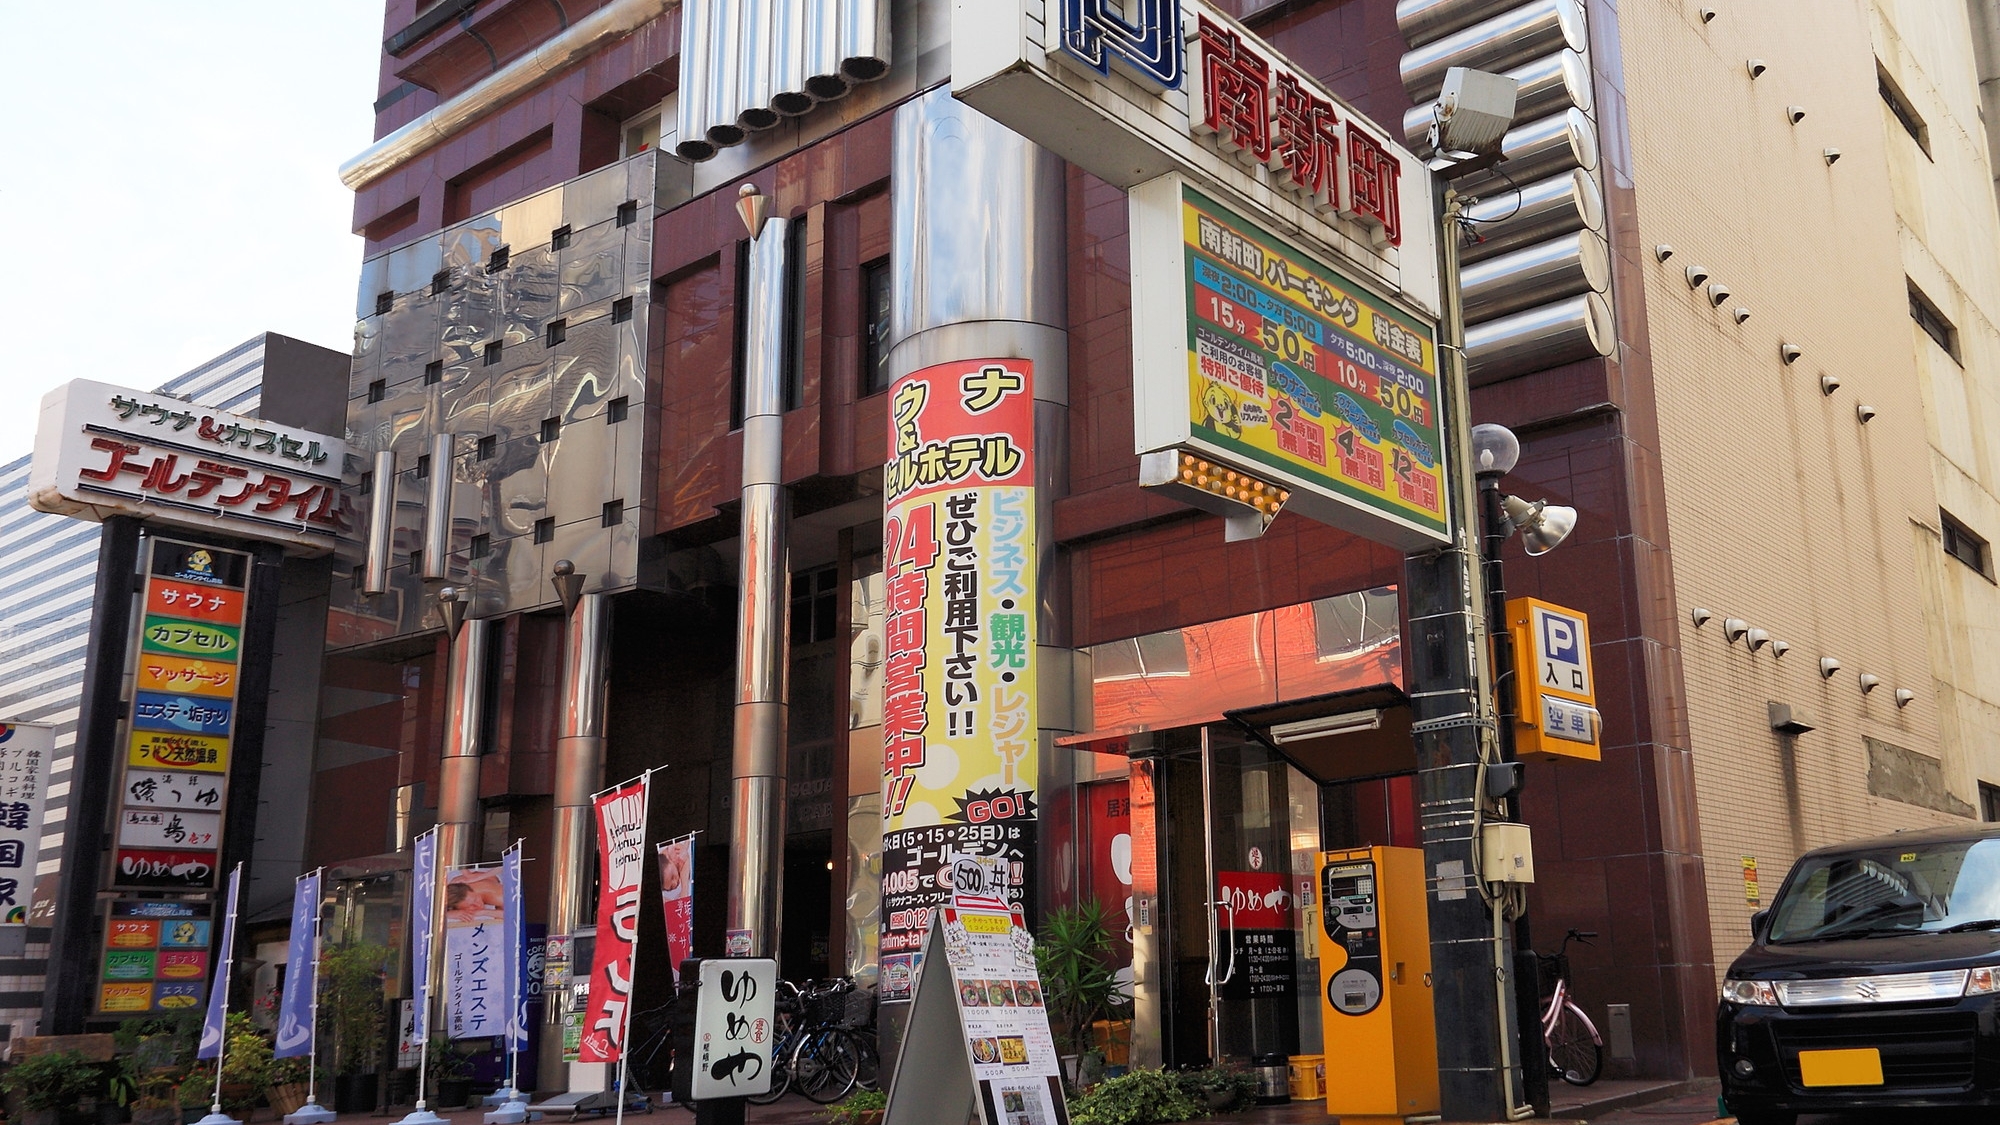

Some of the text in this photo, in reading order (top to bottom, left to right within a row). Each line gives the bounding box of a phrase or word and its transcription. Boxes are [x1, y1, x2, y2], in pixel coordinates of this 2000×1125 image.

[1197, 12, 1402, 248] 南新町
[1198, 213, 1424, 368] 南新町 パーキング 料金表
[1210, 296, 1316, 373] 15分 50円
[1200, 355, 1265, 399] 特別ご優待
[1268, 366, 1321, 405] サウナコース
[1337, 359, 1425, 426] 10分 50円
[1273, 398, 1318, 443] 2時間
[1281, 430, 1323, 464] 無料
[1337, 429, 1378, 471] 4時間
[79, 437, 341, 526] ゴールデンタイム
[1345, 460, 1383, 491] 無料
[1391, 447, 1434, 492] 12時間
[1402, 484, 1438, 513] 無料
[161, 588, 227, 613] サウナ
[943, 492, 979, 737] ぜひご利用下さい!!
[152, 625, 230, 652] カプセル
[990, 491, 1026, 786] ビジネス・観光・レジャー
[147, 665, 230, 688] マッサージ
[1546, 662, 1585, 692] 入口
[137, 701, 230, 727] エステ・垢すり
[1548, 703, 1587, 736] 空車
[6, 748, 25, 799] ブルコギ
[966, 793, 1026, 824] GO!
[121, 855, 211, 882] ゆめや
[1221, 885, 1293, 916] ゆめや
[116, 923, 151, 933] サウナ
[109, 954, 151, 965] カプセル
[469, 922, 489, 1031] メンズエステ
[162, 985, 196, 995] エステ
[711, 968, 763, 1088] ゆめや
